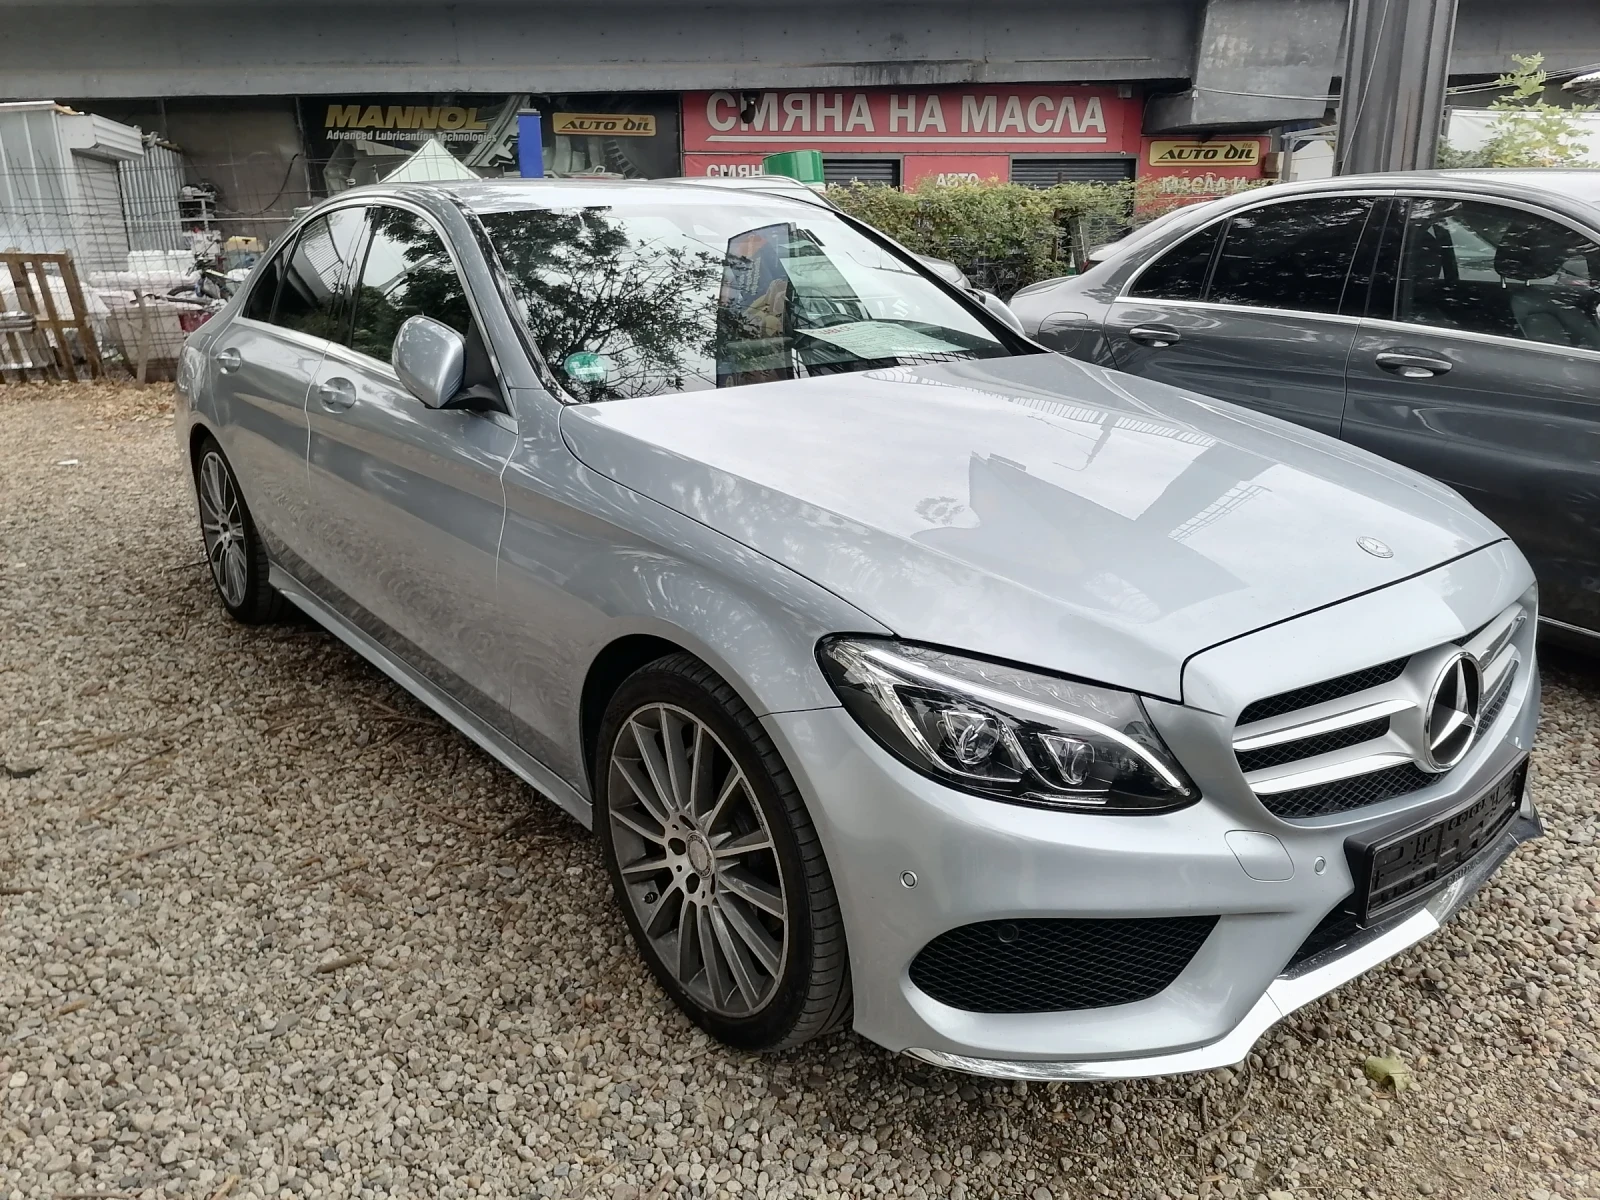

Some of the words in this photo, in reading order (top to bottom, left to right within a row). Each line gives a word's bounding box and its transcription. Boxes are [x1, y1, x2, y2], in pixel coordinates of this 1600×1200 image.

[325, 105, 489, 130] MANNOL
[706, 91, 876, 133] СМЯНА
[889, 94, 947, 133] НА
[961, 95, 1107, 134] МАСЛА
[562, 121, 617, 130] AUTO
[623, 117, 653, 131] OIL
[326, 130, 373, 140] Advanced
[437, 132, 497, 143] Technologies
[1158, 149, 1219, 160] AUTO
[1224, 144, 1256, 160] OIL
[706, 164, 764, 178] СМЯН
